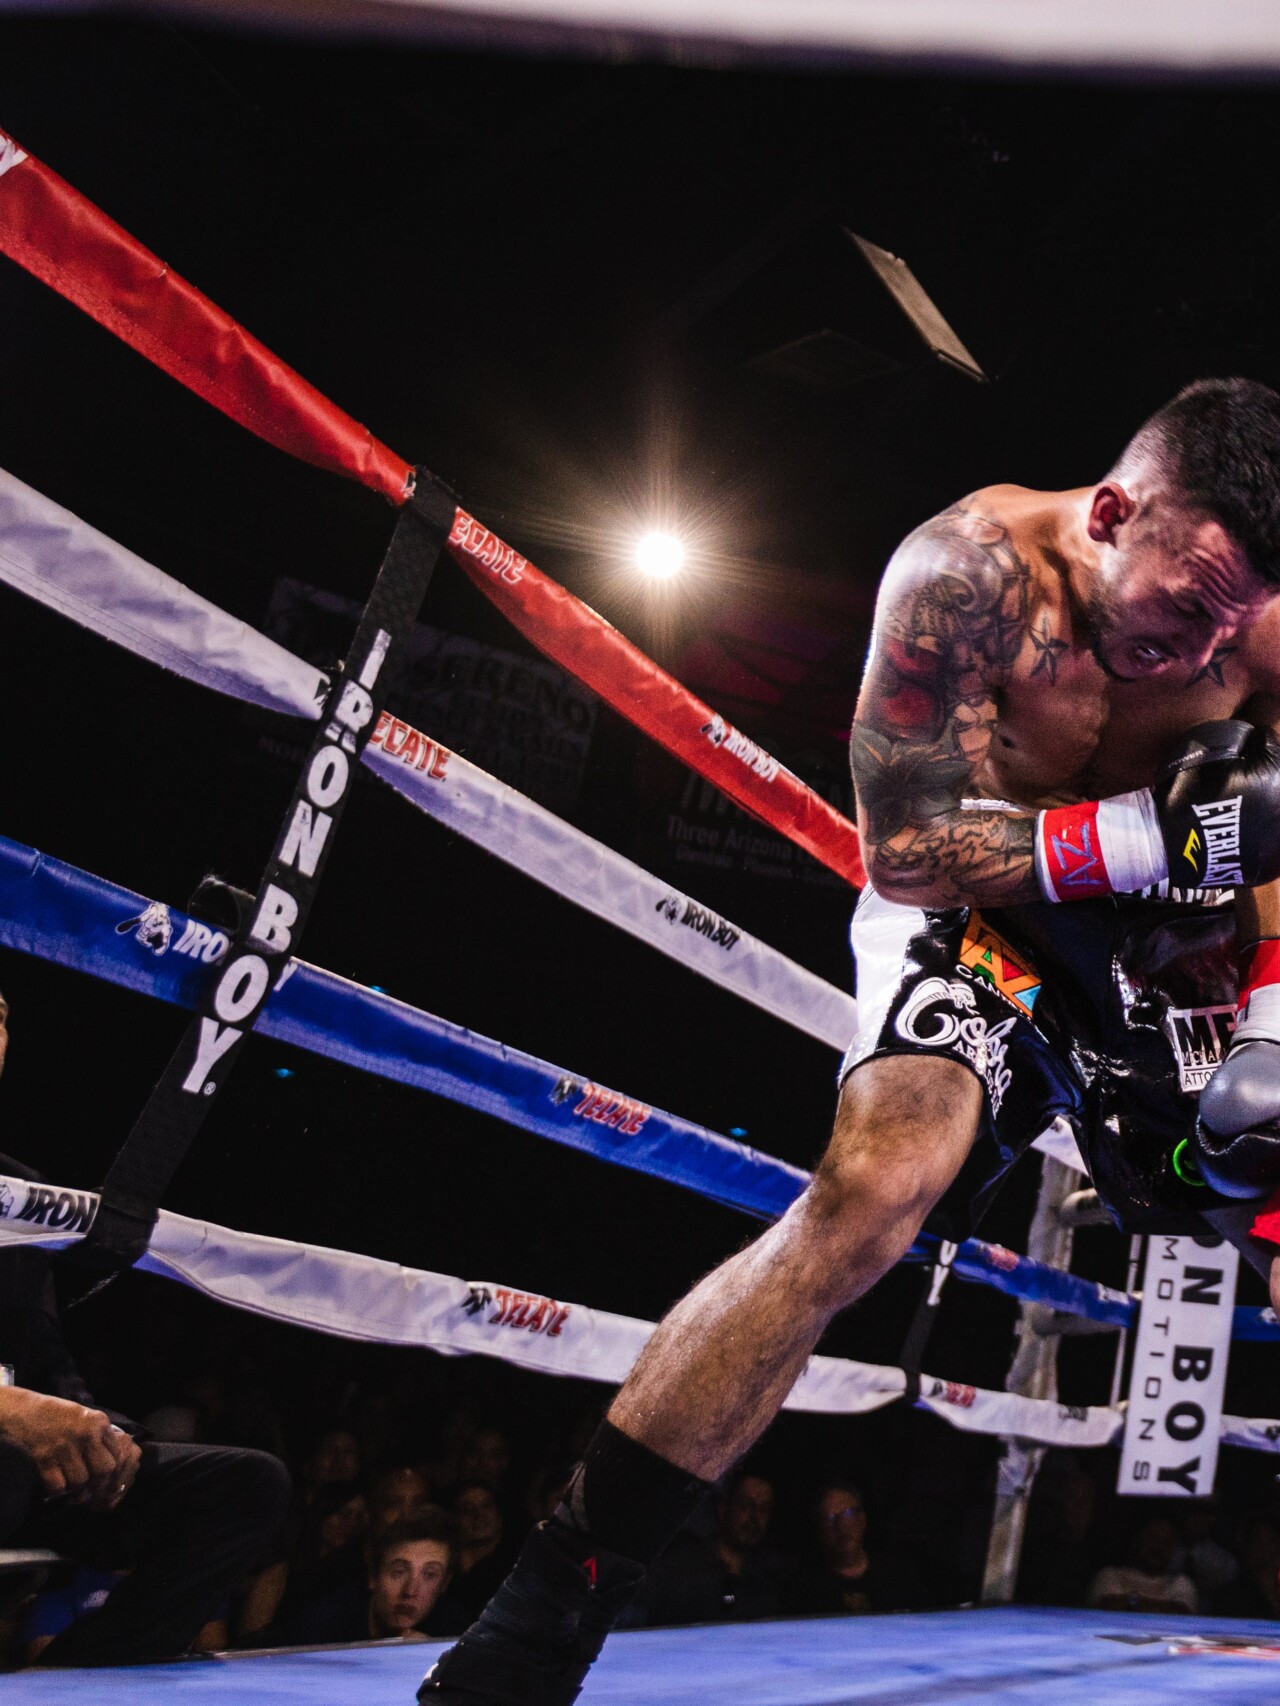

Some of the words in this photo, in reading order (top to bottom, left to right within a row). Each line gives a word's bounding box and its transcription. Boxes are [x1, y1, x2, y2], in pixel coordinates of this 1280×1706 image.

[449, 506, 527, 584] ECATE
[369, 710, 451, 780] ECATE
[1191, 795, 1245, 889] EVERLAST
[173, 919, 231, 964] IRO
[573, 1081, 652, 1136] TECATE
[1184, 1071, 1214, 1086] ATTO
[14, 1186, 98, 1234] IRON
[1132, 1237, 1180, 1482] MOTIONS
[1157, 1345, 1214, 1493] BOY
